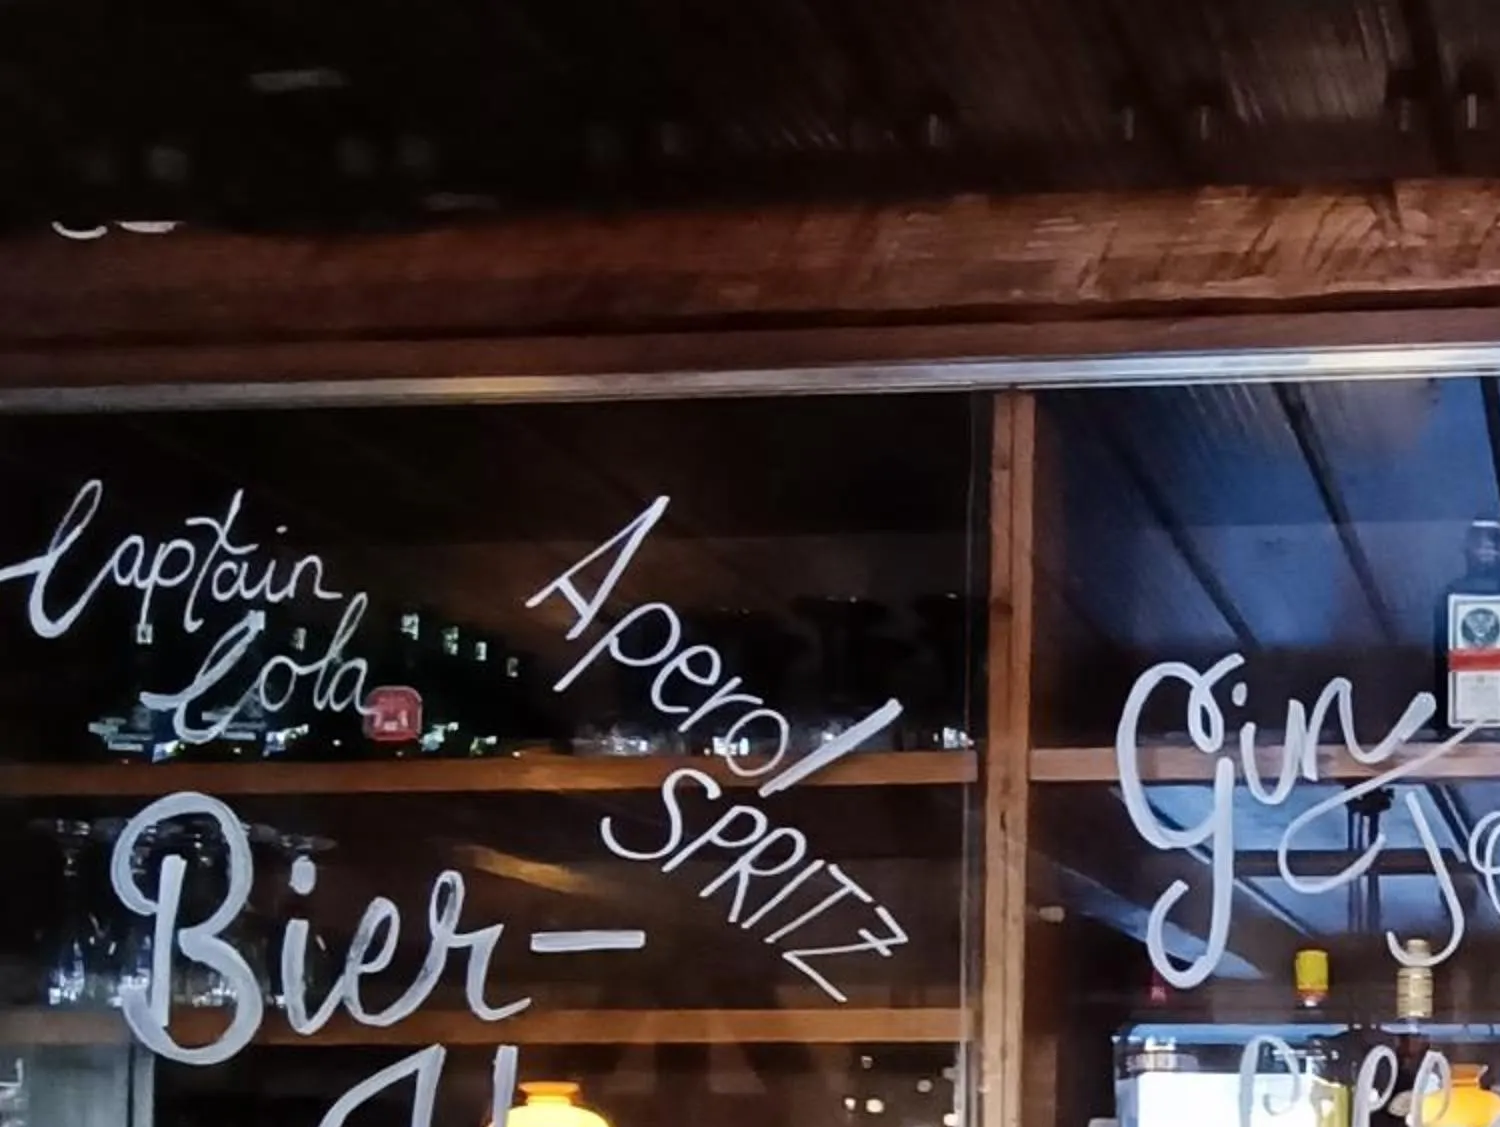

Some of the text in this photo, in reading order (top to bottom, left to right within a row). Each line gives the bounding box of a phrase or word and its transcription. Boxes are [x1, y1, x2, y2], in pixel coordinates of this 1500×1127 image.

[0, 479, 343, 638] Captain
[140, 592, 379, 743] Cola
[525, 495, 904, 798] Aperol
[601, 768, 910, 1003] SPRITZ
[1116, 653, 1437, 989] Gin
